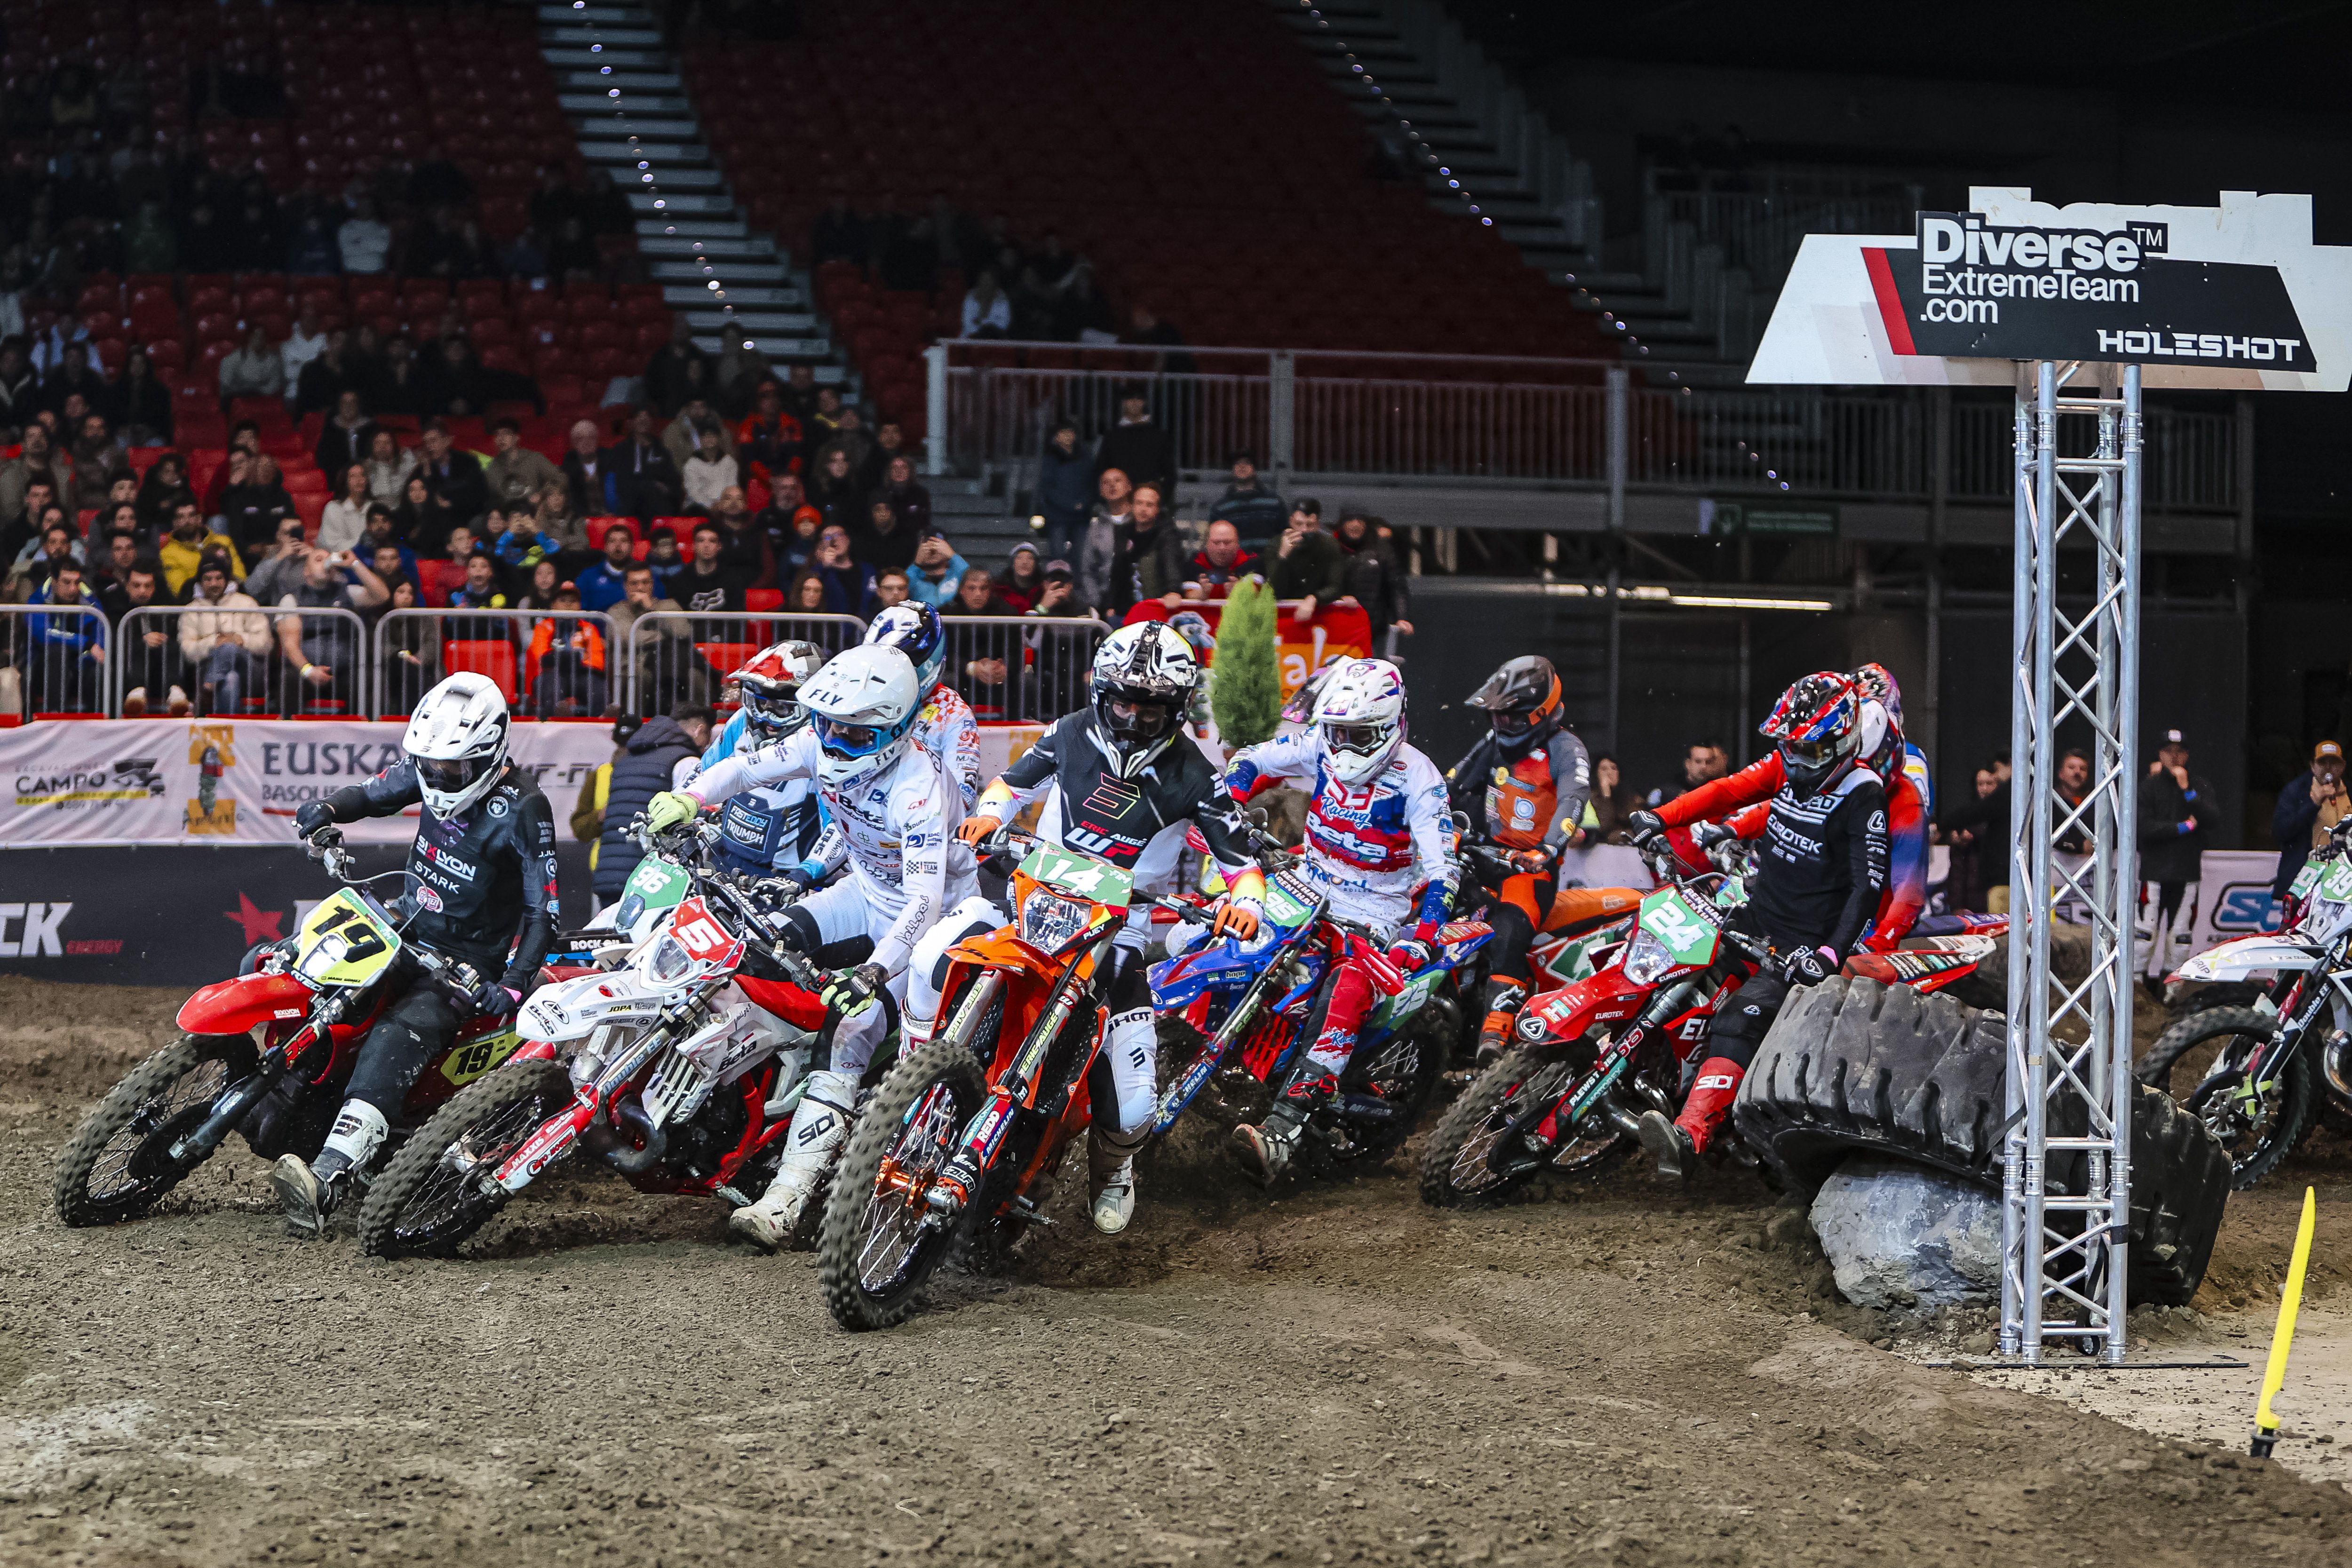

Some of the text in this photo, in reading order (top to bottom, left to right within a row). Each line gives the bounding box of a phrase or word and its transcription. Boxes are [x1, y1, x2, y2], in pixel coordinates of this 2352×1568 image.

[1923, 218, 2140, 272] Diverse
[1923, 265, 2139, 303] ExtremeTeam
[1920, 299, 1999, 324] .com
[2096, 329, 2300, 362] HOLESHOT
[808, 689, 843, 706] FLY
[874, 746, 896, 767] FLY
[839, 793, 883, 824] Beta
[1321, 796, 1372, 830] Racing
[727, 819, 764, 844] TRIUMPH
[1081, 820, 1109, 835] ERIC
[1307, 810, 1388, 858] Beta
[417, 835, 477, 877] SIXLYON
[415, 860, 461, 894] STARK
[631, 866, 672, 893] 96
[1044, 858, 1105, 893] 14
[1280, 871, 1321, 901] RENTHAL
[2324, 865, 2352, 897] 39
[725, 882, 772, 926] Double EE
[1686, 887, 1724, 925] RENTHAL
[312, 905, 386, 963] 19
[677, 917, 725, 952] 5
[1083, 923, 1105, 940] PUEY
[1643, 901, 1707, 953] 24
[570, 939, 602, 951] ROCK
[291, 970, 325, 992] RTEC
[1658, 966, 1692, 982] EUROTEK
[2192, 958, 2210, 974] GRIP
[529, 1004, 555, 1035] Beta
[1595, 1010, 1624, 1020] EUROTEK
[454, 1042, 494, 1076] 19
[717, 1040, 757, 1073] Beta
[1021, 1044, 1037, 1073] ERIC
[602, 1053, 645, 1096] Double
[1569, 1077, 1596, 1106] PLEWS
[977, 1110, 1001, 1143] REDD
[985, 1107, 1015, 1154] MICHELIN
[511, 1138, 545, 1168] MAXXIS
